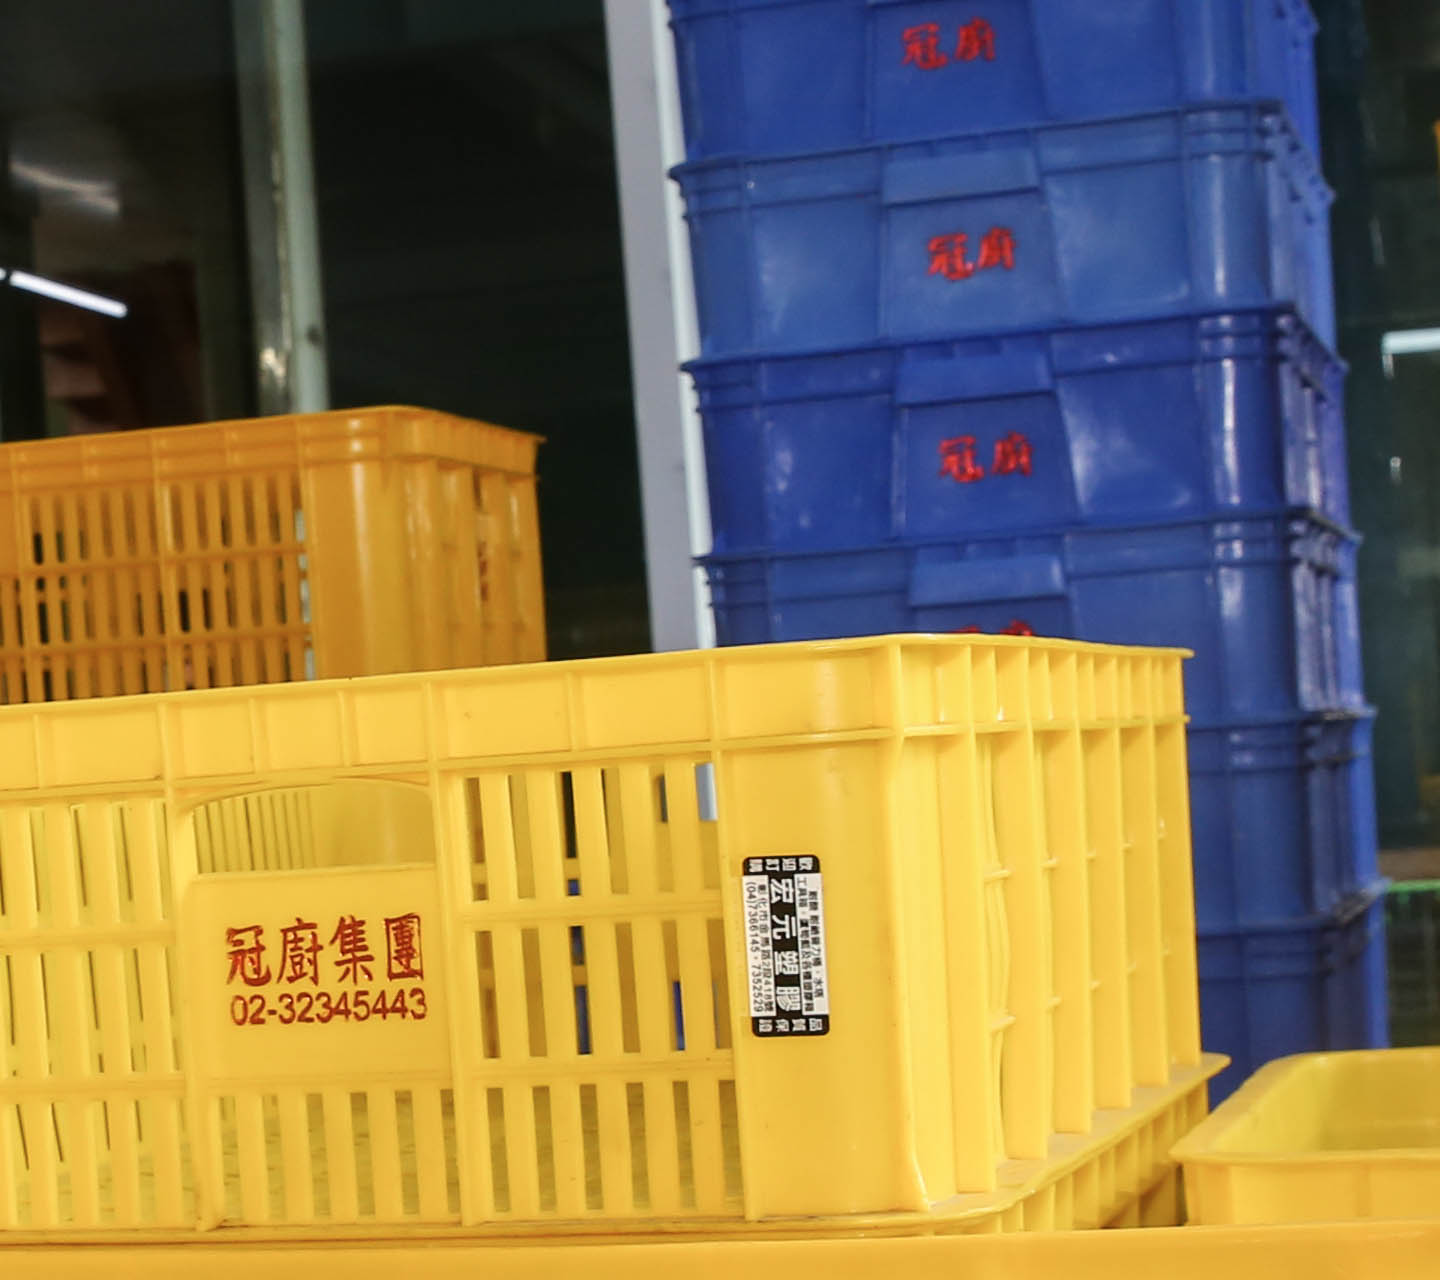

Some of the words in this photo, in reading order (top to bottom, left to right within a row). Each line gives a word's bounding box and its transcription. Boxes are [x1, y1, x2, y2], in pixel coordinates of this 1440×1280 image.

[900, 16, 996, 71] 冠廚
[937, 430, 1033, 485] 冠廚
[225, 912, 425, 988] 冠廚集團
[770, 878, 802, 1012] 宏元塑膠
[230, 985, 428, 1027] 02-32345443
